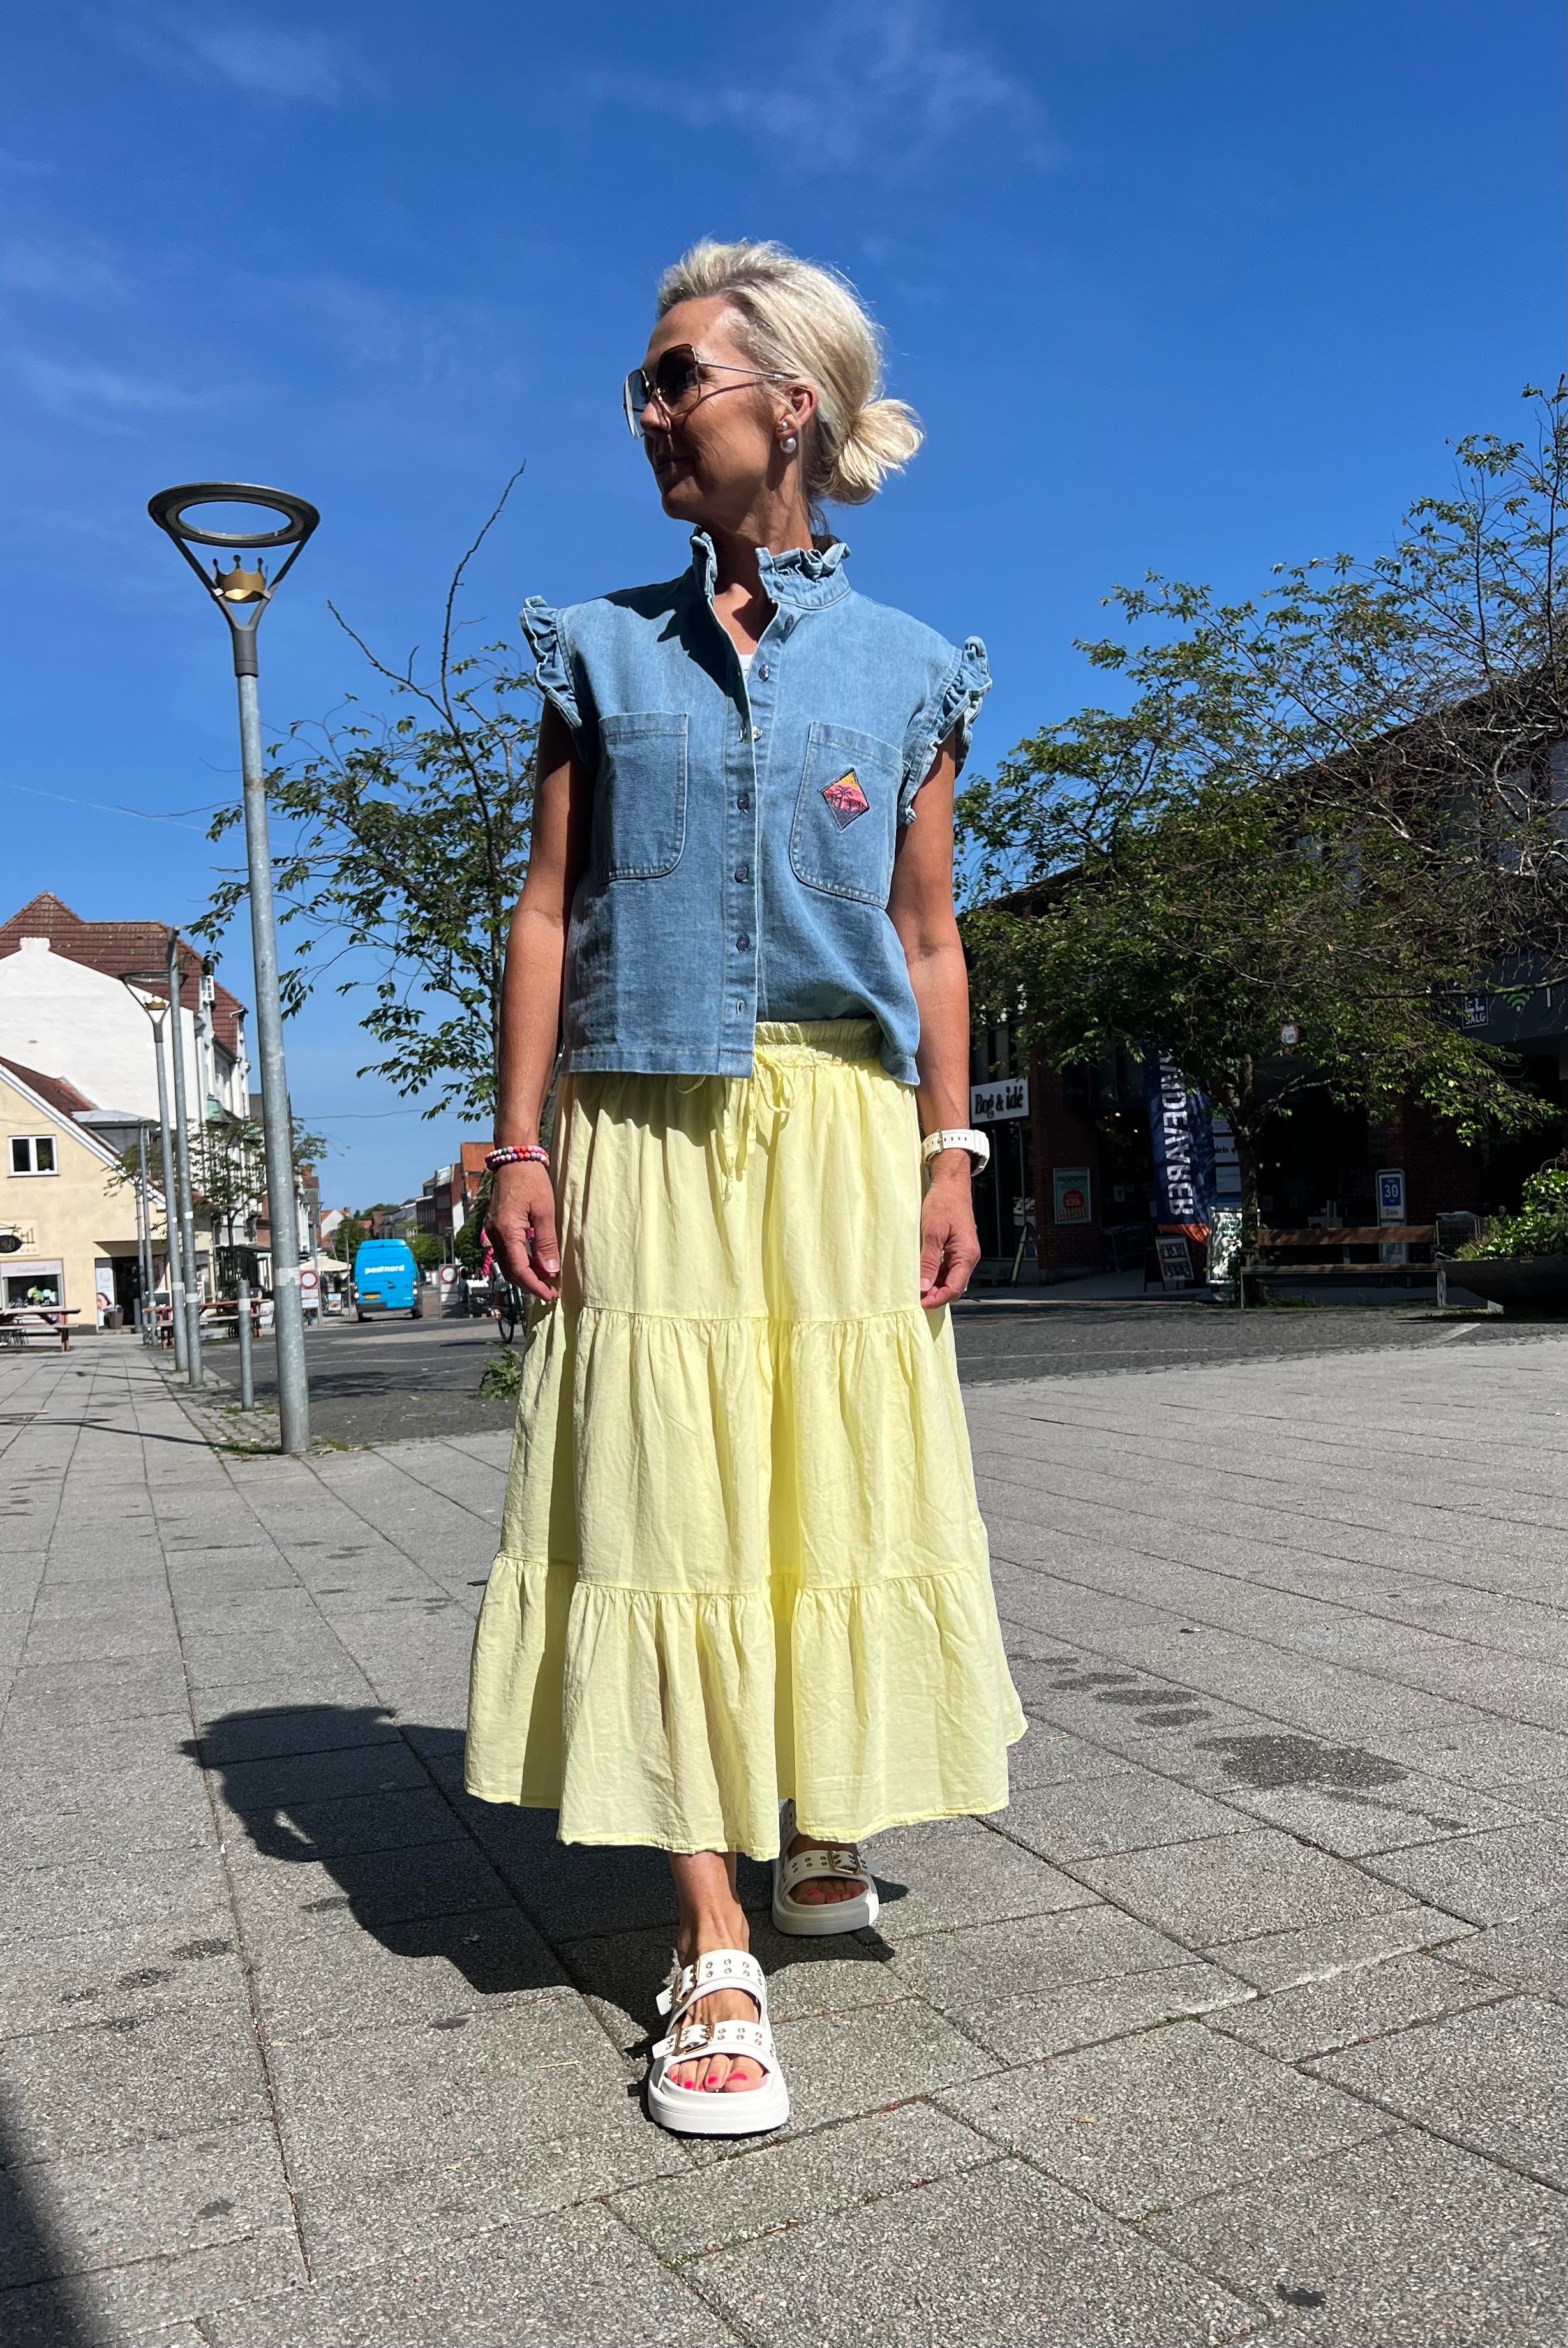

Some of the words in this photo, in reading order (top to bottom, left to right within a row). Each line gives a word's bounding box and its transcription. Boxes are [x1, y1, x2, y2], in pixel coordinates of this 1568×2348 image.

[1465, 1012, 1486, 1024] SALG
[975, 1093, 994, 1118] Bog
[996, 1093, 1003, 1111] &
[1006, 1086, 1023, 1110] idé
[1384, 1185, 1398, 1197] 30
[364, 1264, 405, 1275] postnord
